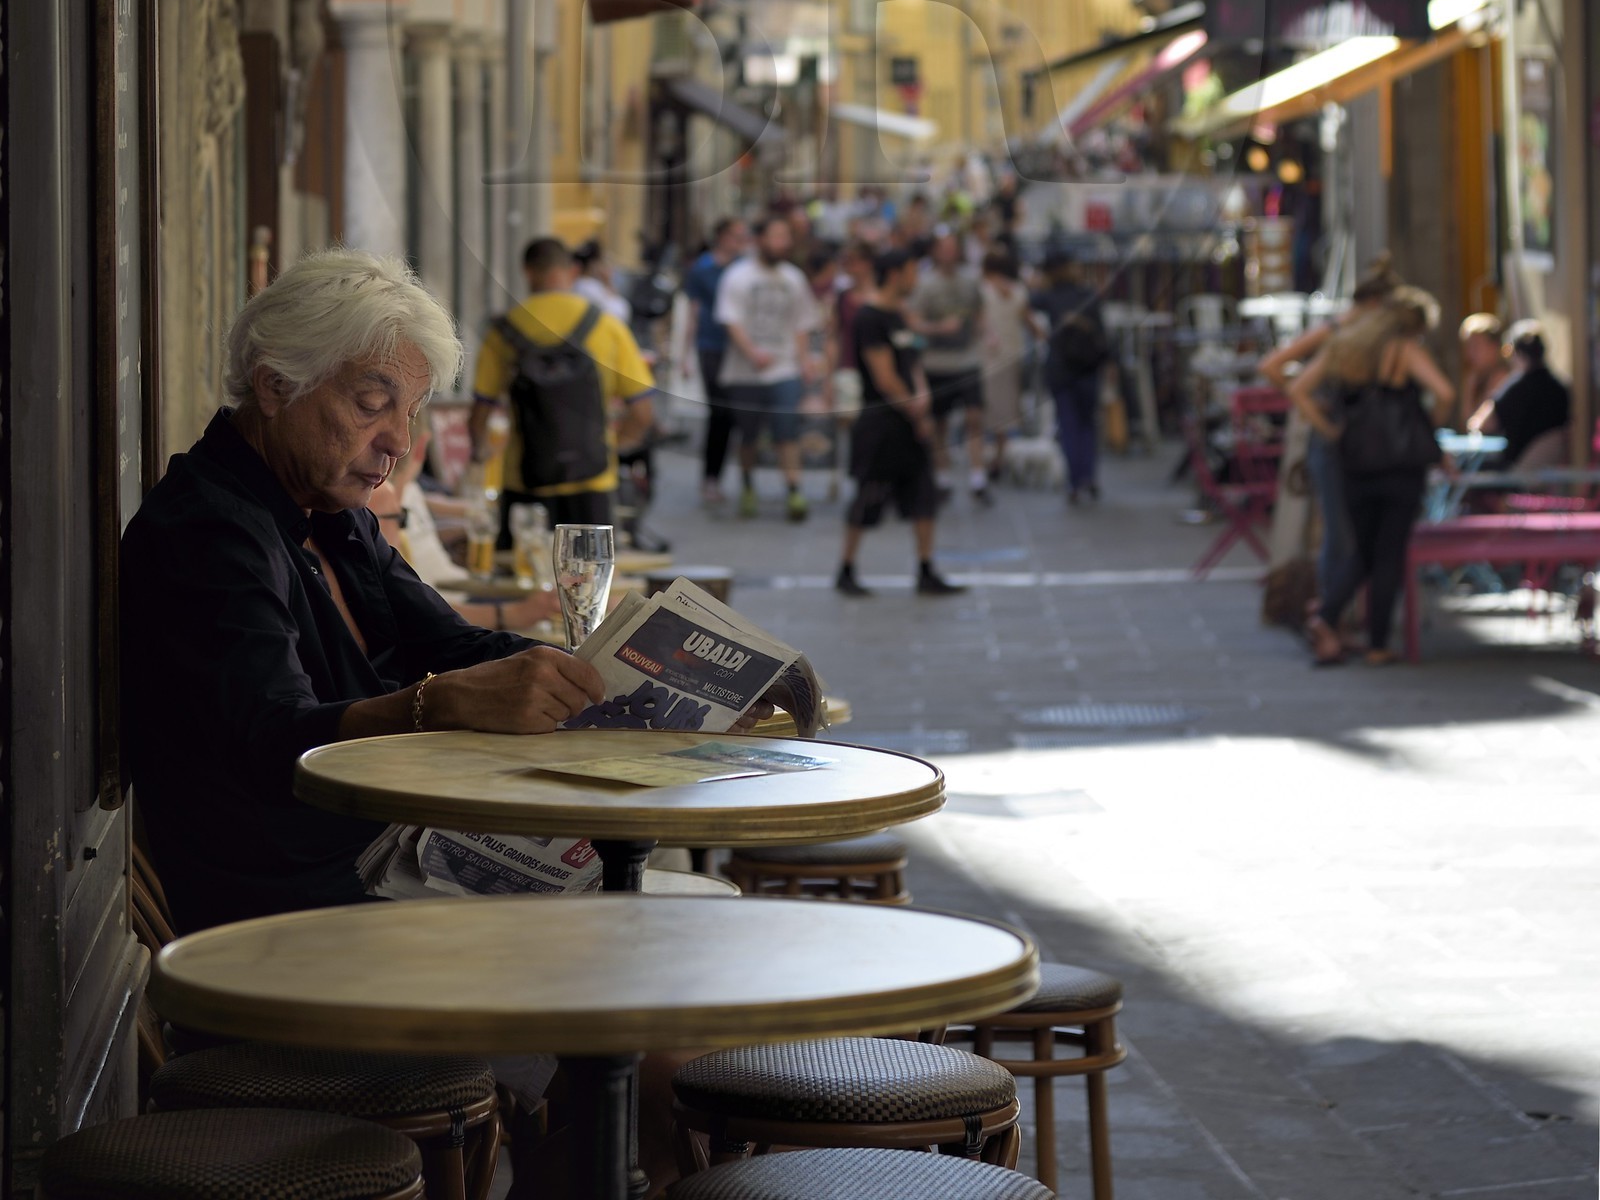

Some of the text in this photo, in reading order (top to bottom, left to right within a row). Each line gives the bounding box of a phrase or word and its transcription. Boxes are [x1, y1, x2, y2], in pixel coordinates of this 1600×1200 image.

[622, 647, 662, 673] NOUVEAU
[682, 630, 752, 672] UBALDI
[713, 668, 735, 680] .com
[702, 682, 744, 704] MULTISTORE
[429, 834, 466, 857] ELECTRO
[465, 853, 501, 873] SALONS
[499, 870, 529, 886] LITERIE
[480, 835, 506, 853] PLUS
[503, 847, 541, 869] GRANDES
[536, 862, 573, 881] MARQUES
